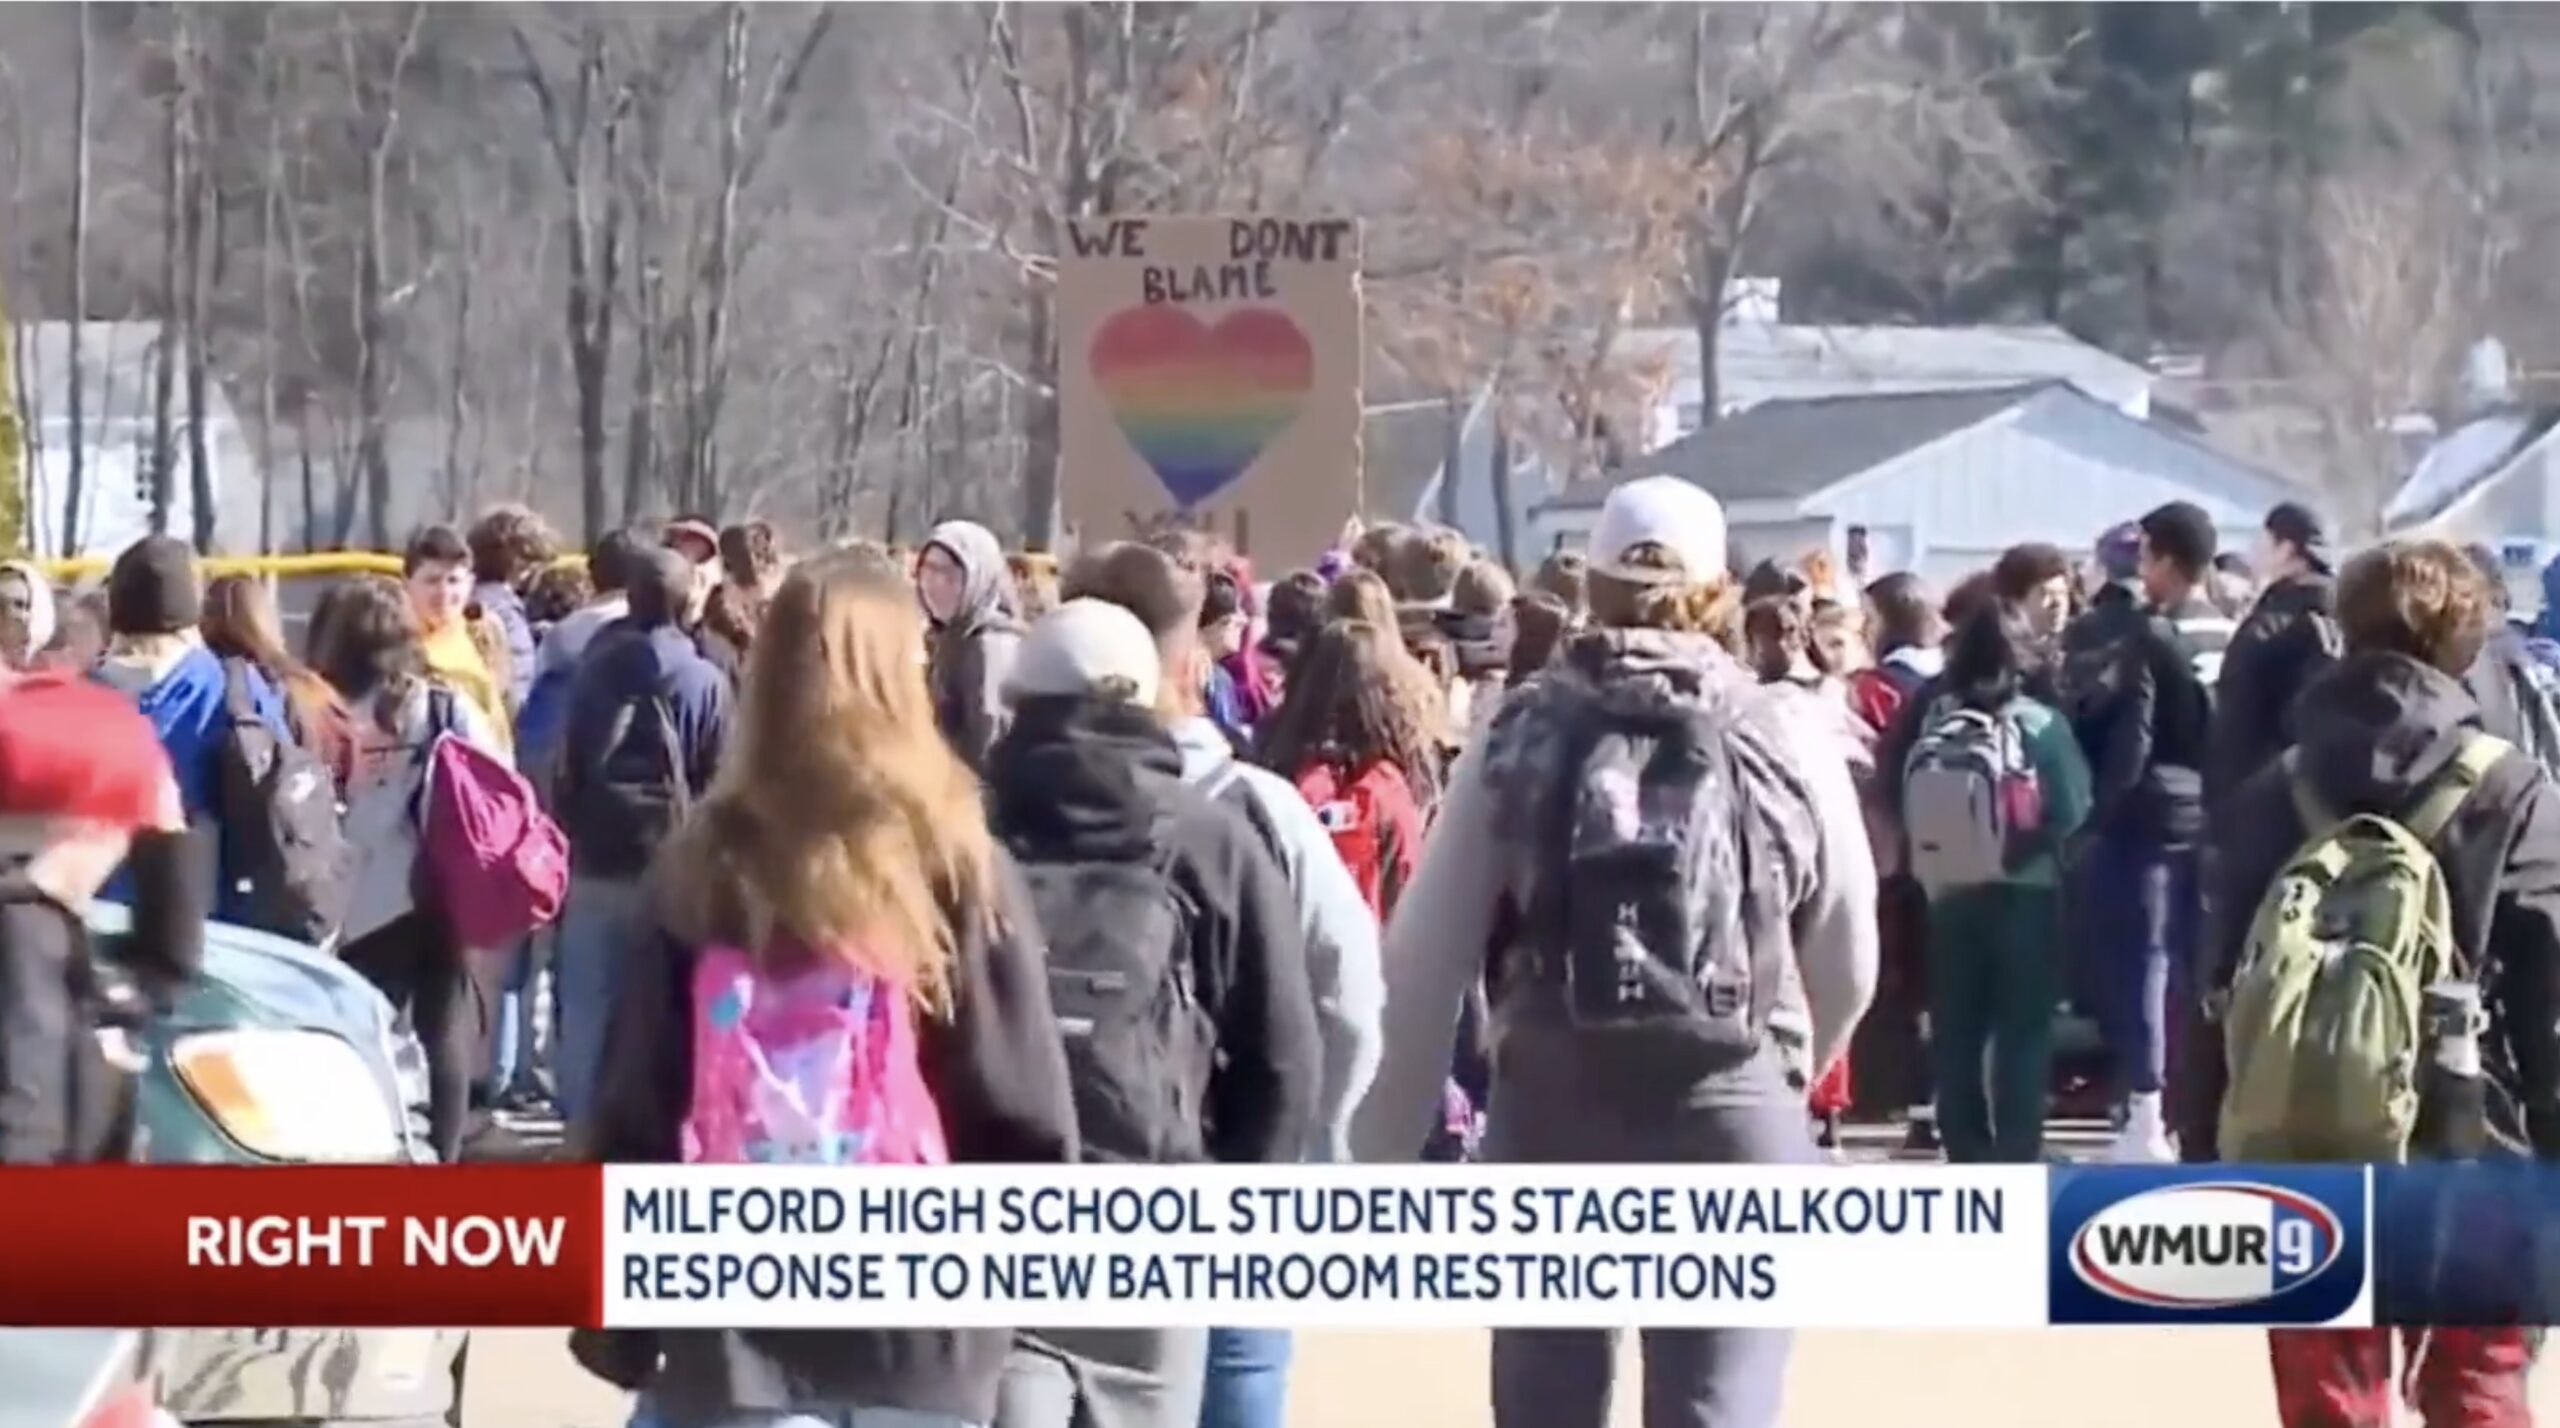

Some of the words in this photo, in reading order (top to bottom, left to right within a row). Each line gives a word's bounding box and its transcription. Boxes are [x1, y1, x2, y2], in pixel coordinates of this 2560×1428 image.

[1068, 219, 1148, 257] WE
[1229, 218, 1350, 261] DONT
[1143, 261, 1276, 304] BLAME
